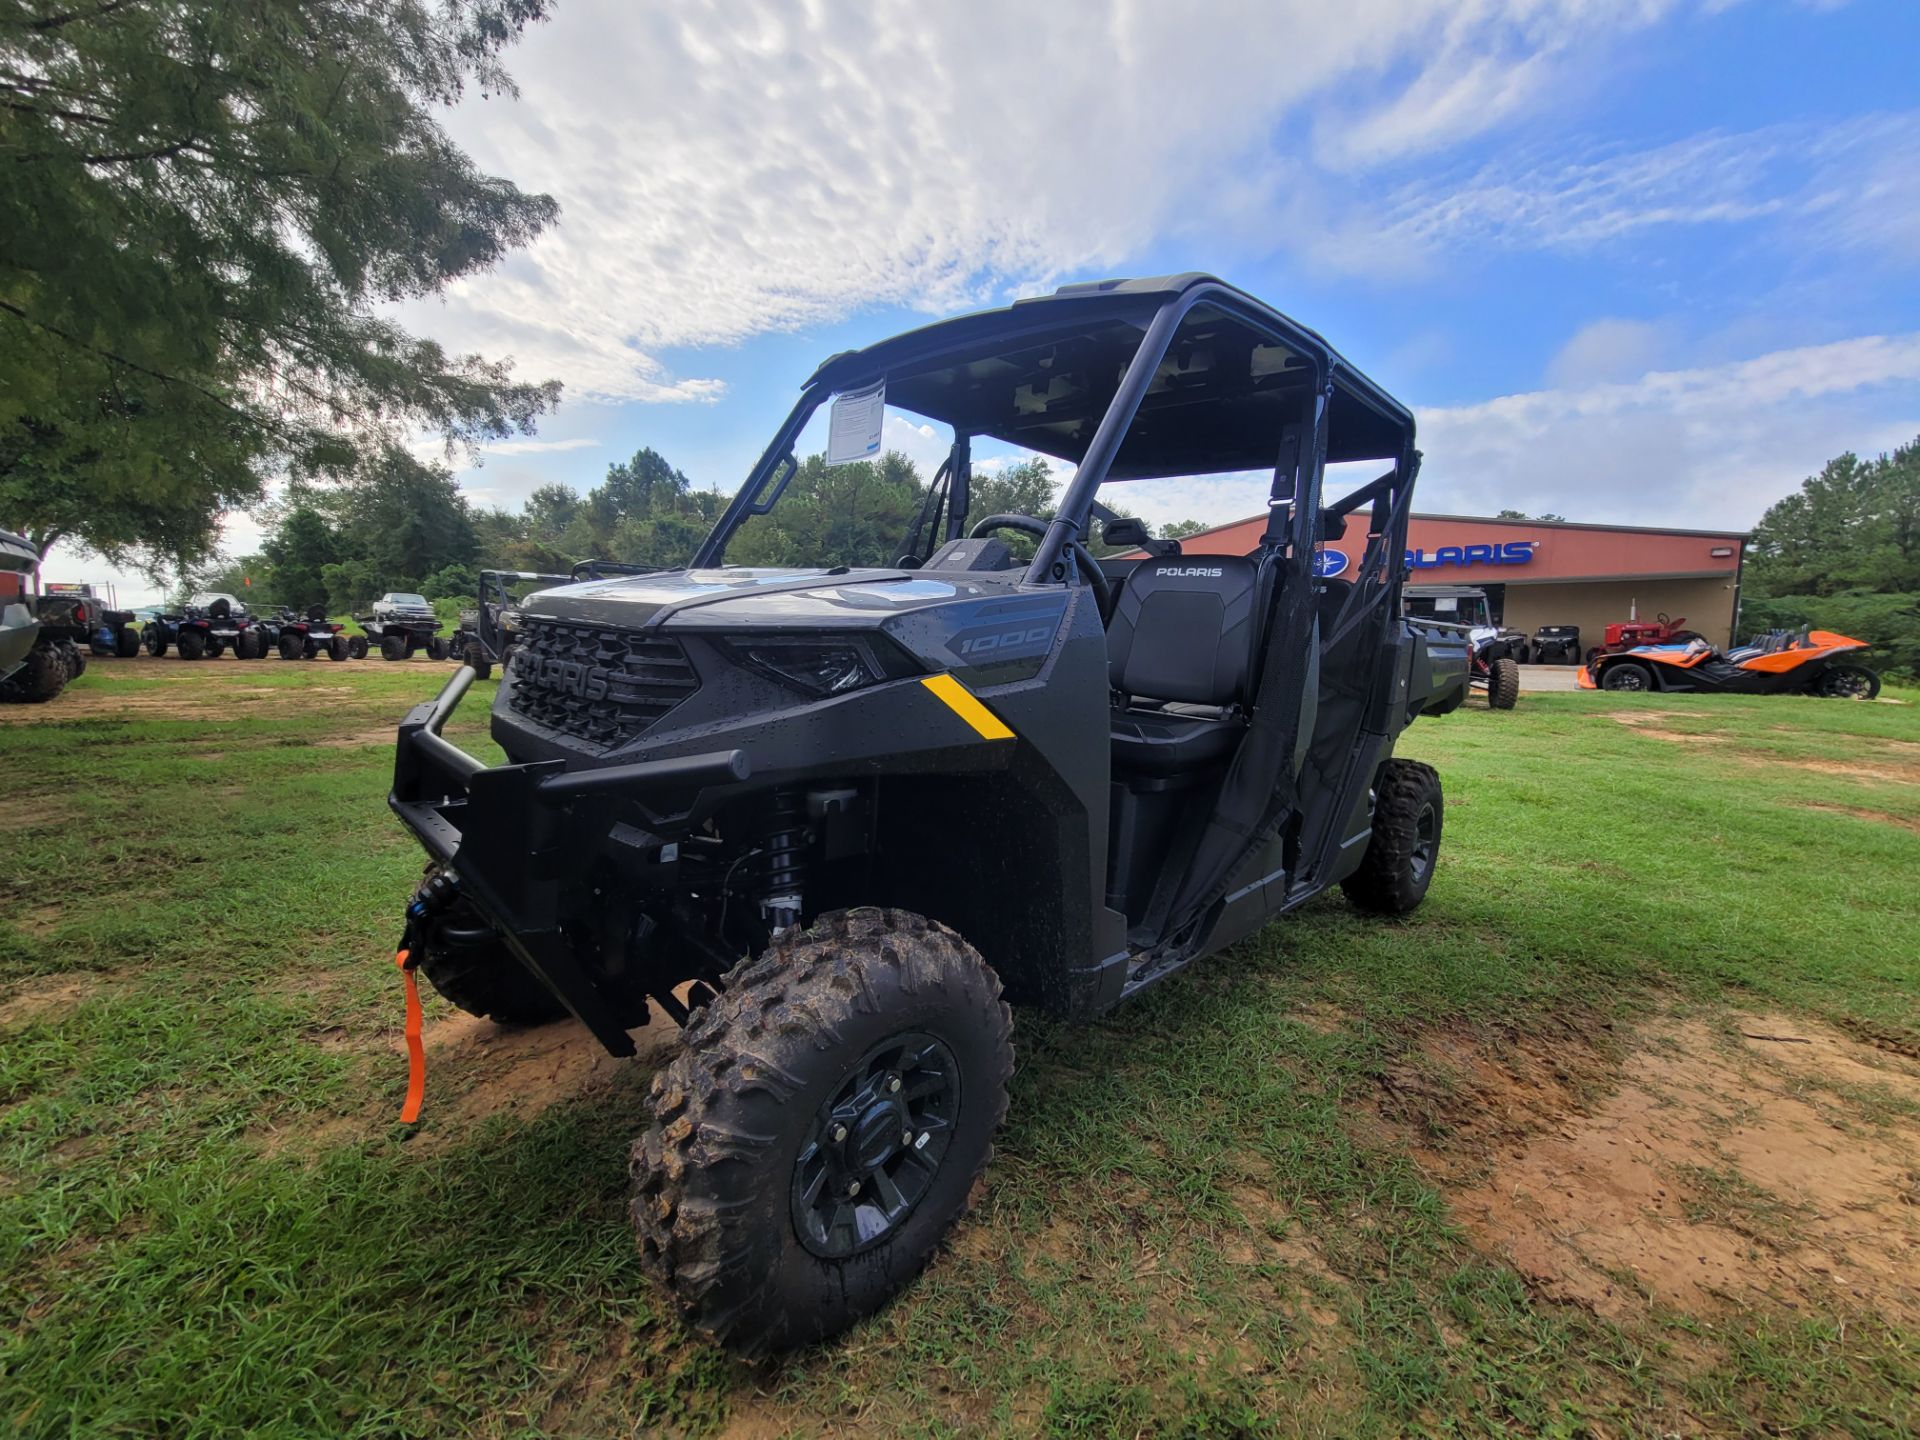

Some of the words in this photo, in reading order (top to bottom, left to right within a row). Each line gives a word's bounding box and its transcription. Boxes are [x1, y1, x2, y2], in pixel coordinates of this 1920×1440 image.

[1363, 542, 1534, 569] LARIS
[1156, 567, 1222, 578] POLARIS
[960, 627, 1050, 654] 1000
[513, 651, 609, 702] POLARIS
